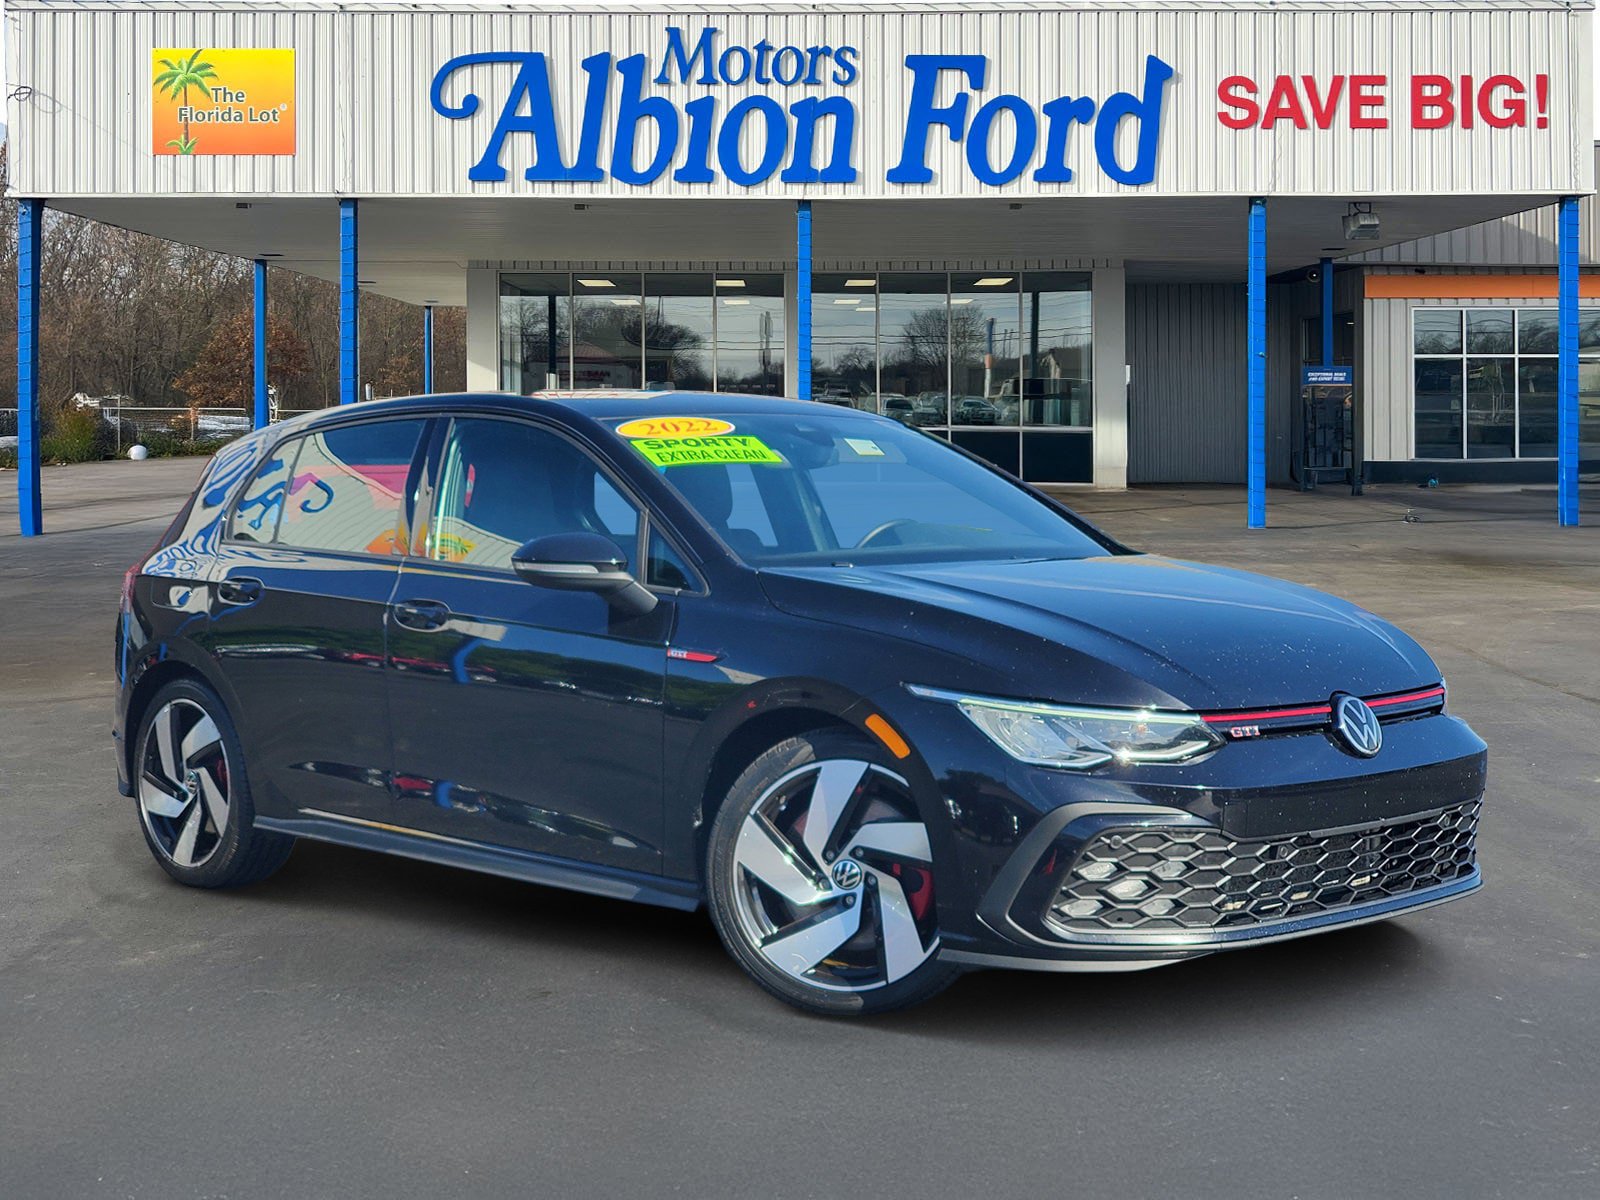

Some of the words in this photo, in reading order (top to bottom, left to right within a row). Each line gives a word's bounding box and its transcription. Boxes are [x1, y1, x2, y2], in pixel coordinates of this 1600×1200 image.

[653, 26, 858, 86] Motors
[211, 87, 245, 103] The
[1217, 74, 1389, 130] SAVE
[1411, 73, 1549, 130] BIG!
[178, 106, 243, 122] Florida
[248, 107, 279, 122] Lot
[430, 51, 858, 187] Albion
[886, 54, 1174, 187] Ford
[638, 419, 718, 436] 2022
[643, 436, 750, 451] SPORTY
[656, 449, 711, 463] EXTRA
[713, 448, 768, 461] CLEAN
[1230, 725, 1261, 738] GTI
